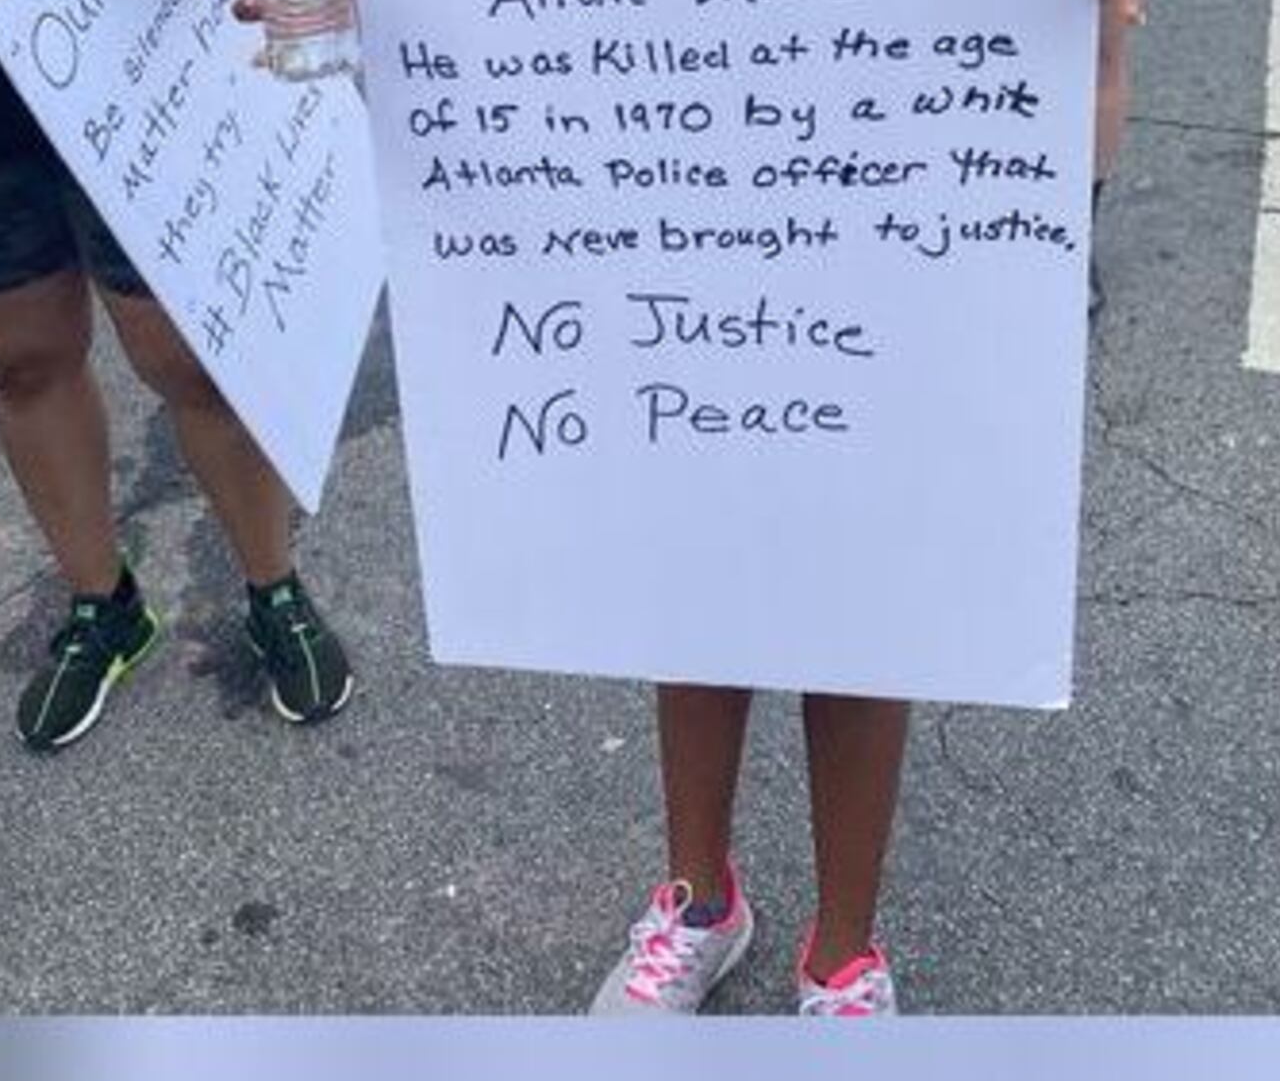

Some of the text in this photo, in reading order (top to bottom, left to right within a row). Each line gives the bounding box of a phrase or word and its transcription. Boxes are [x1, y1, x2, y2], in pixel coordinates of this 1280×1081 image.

[399, 27, 1019, 80] He was Killed at the age
[82, 102, 127, 163] Be
[477, 103, 520, 134] 15
[544, 104, 590, 134] in
[614, 101, 714, 134] 1970
[744, 92, 818, 142] by
[850, 97, 887, 121] a
[421, 147, 1058, 192] Atlanta Police officer that
[262, 153, 335, 334] Matter
[433, 230, 520, 260] was
[659, 216, 839, 260] brought
[874, 212, 921, 243] to
[492, 292, 875, 358] No Justice
[499, 380, 850, 462] No Peace
